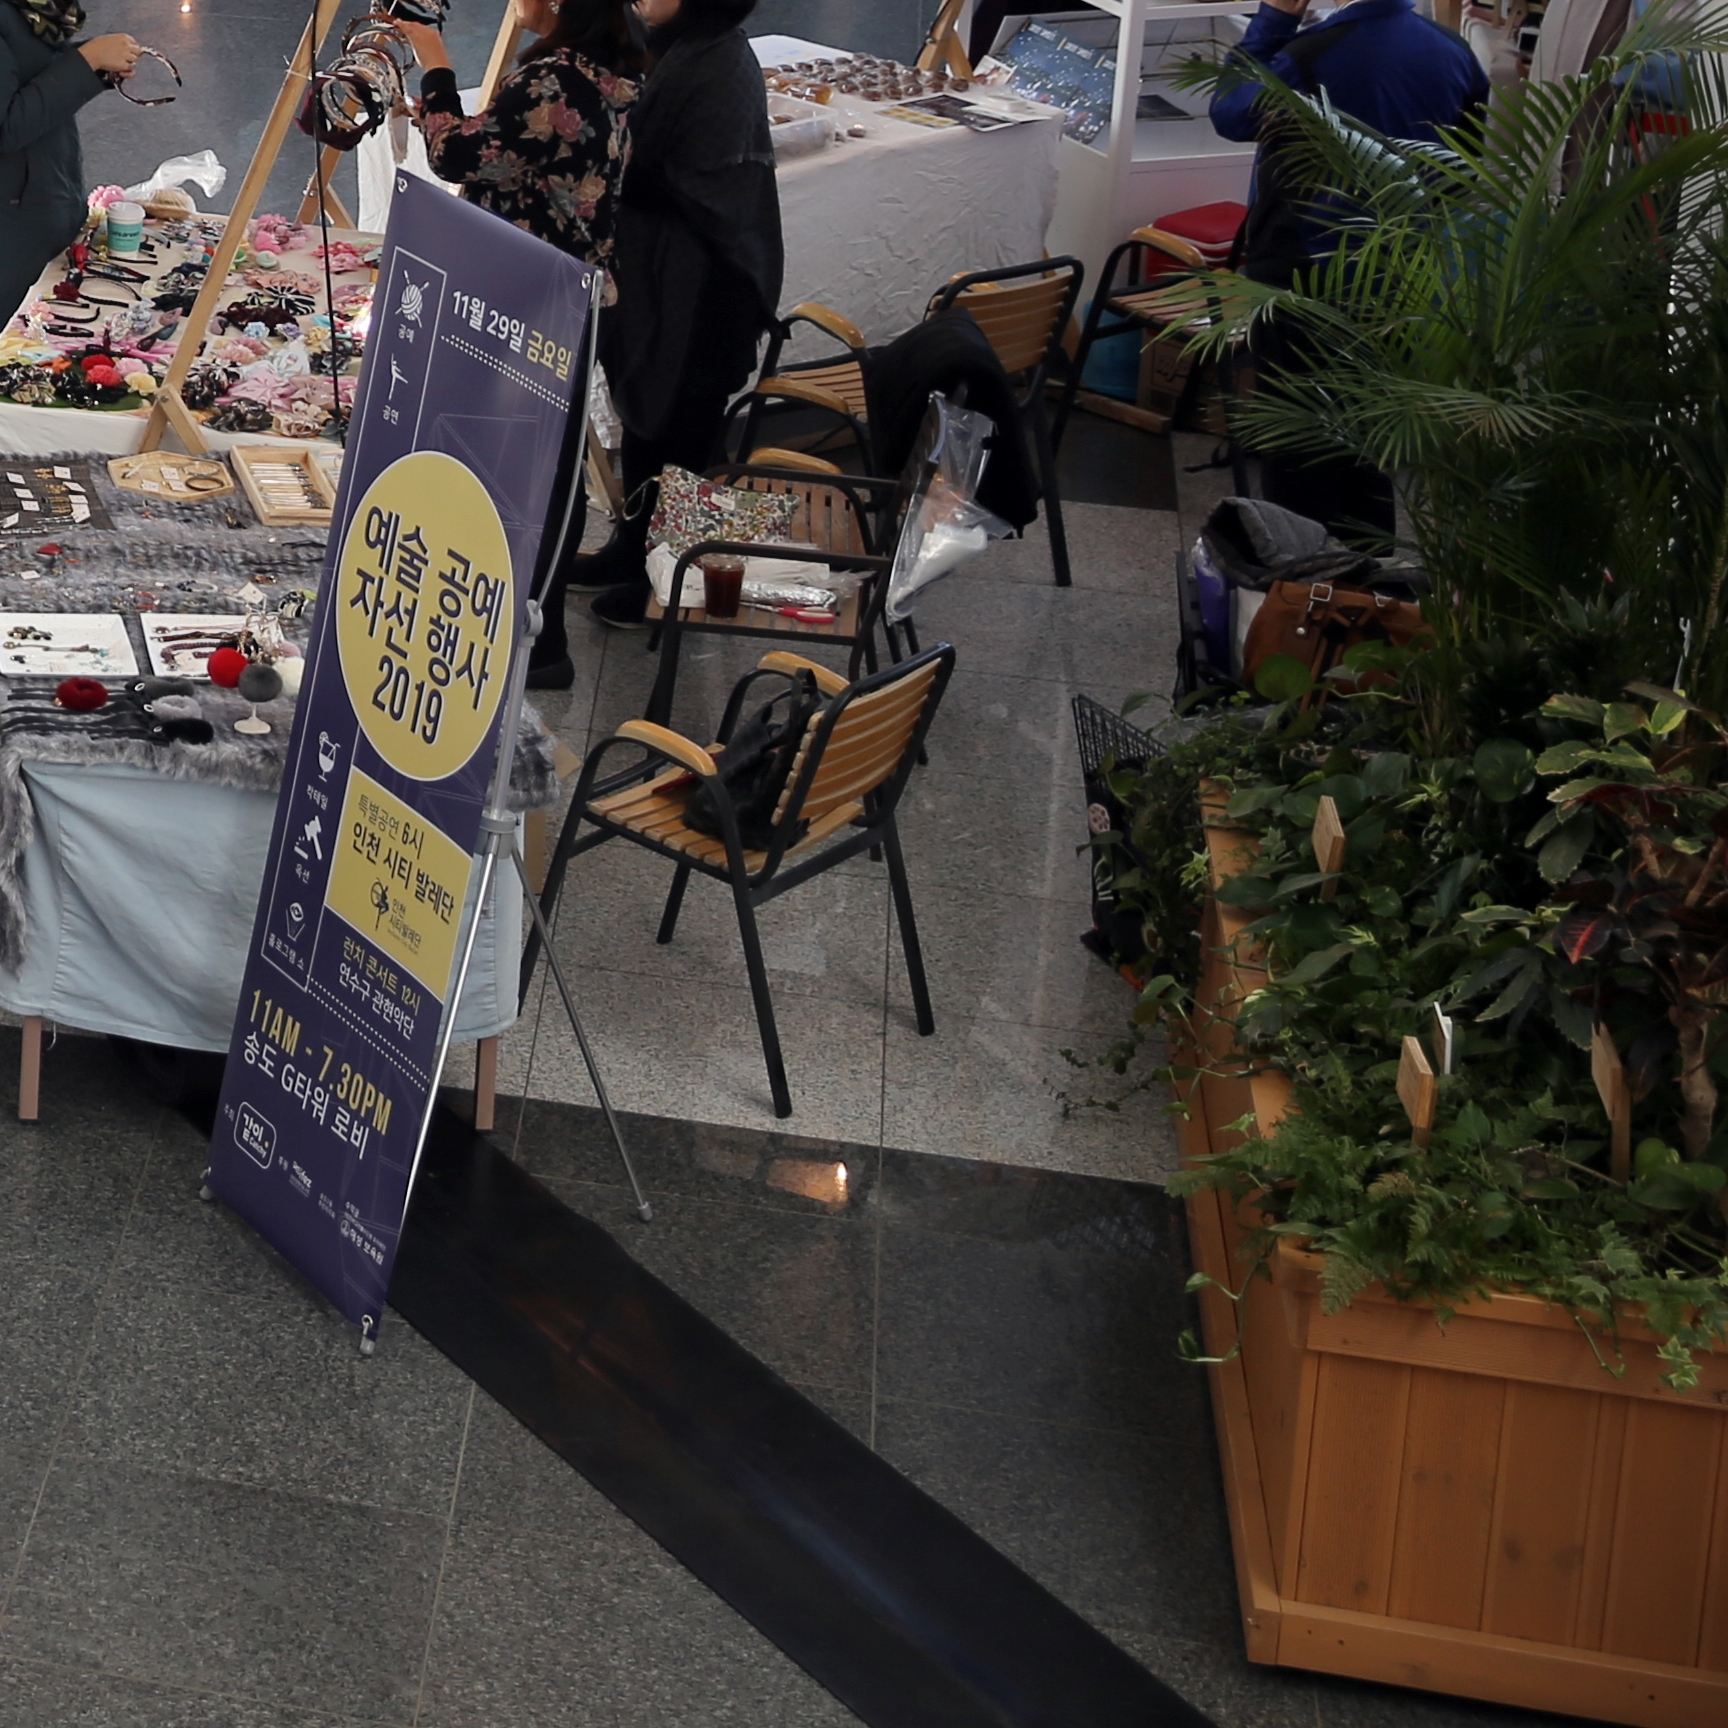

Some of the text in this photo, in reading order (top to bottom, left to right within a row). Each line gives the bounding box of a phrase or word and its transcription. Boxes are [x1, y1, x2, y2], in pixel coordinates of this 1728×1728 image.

[452, 290, 572, 382] 11월 29일 금요일
[382, 404, 399, 426] 공연
[364, 505, 507, 646] 예술 공예
[349, 567, 491, 712] 자선 행사
[371, 654, 444, 746] 2019
[306, 784, 329, 811] 칵테일
[357, 793, 425, 860] 특별공연 6시
[294, 863, 311, 884] 옥션
[352, 821, 455, 926] 인천 시티 발레단
[391, 898, 407, 917] 인천
[388, 915, 422, 950] 시티발레단
[339, 961, 416, 1041] 연수구 관현악단
[341, 935, 366, 969] 런치
[366, 955, 399, 995] 콘서트
[400, 984, 421, 1016] 12시
[244, 1030, 370, 1161] 송도 G타워 로비
[250, 988, 301, 1058] 11AM
[318, 1044, 393, 1136] 7.30PM
